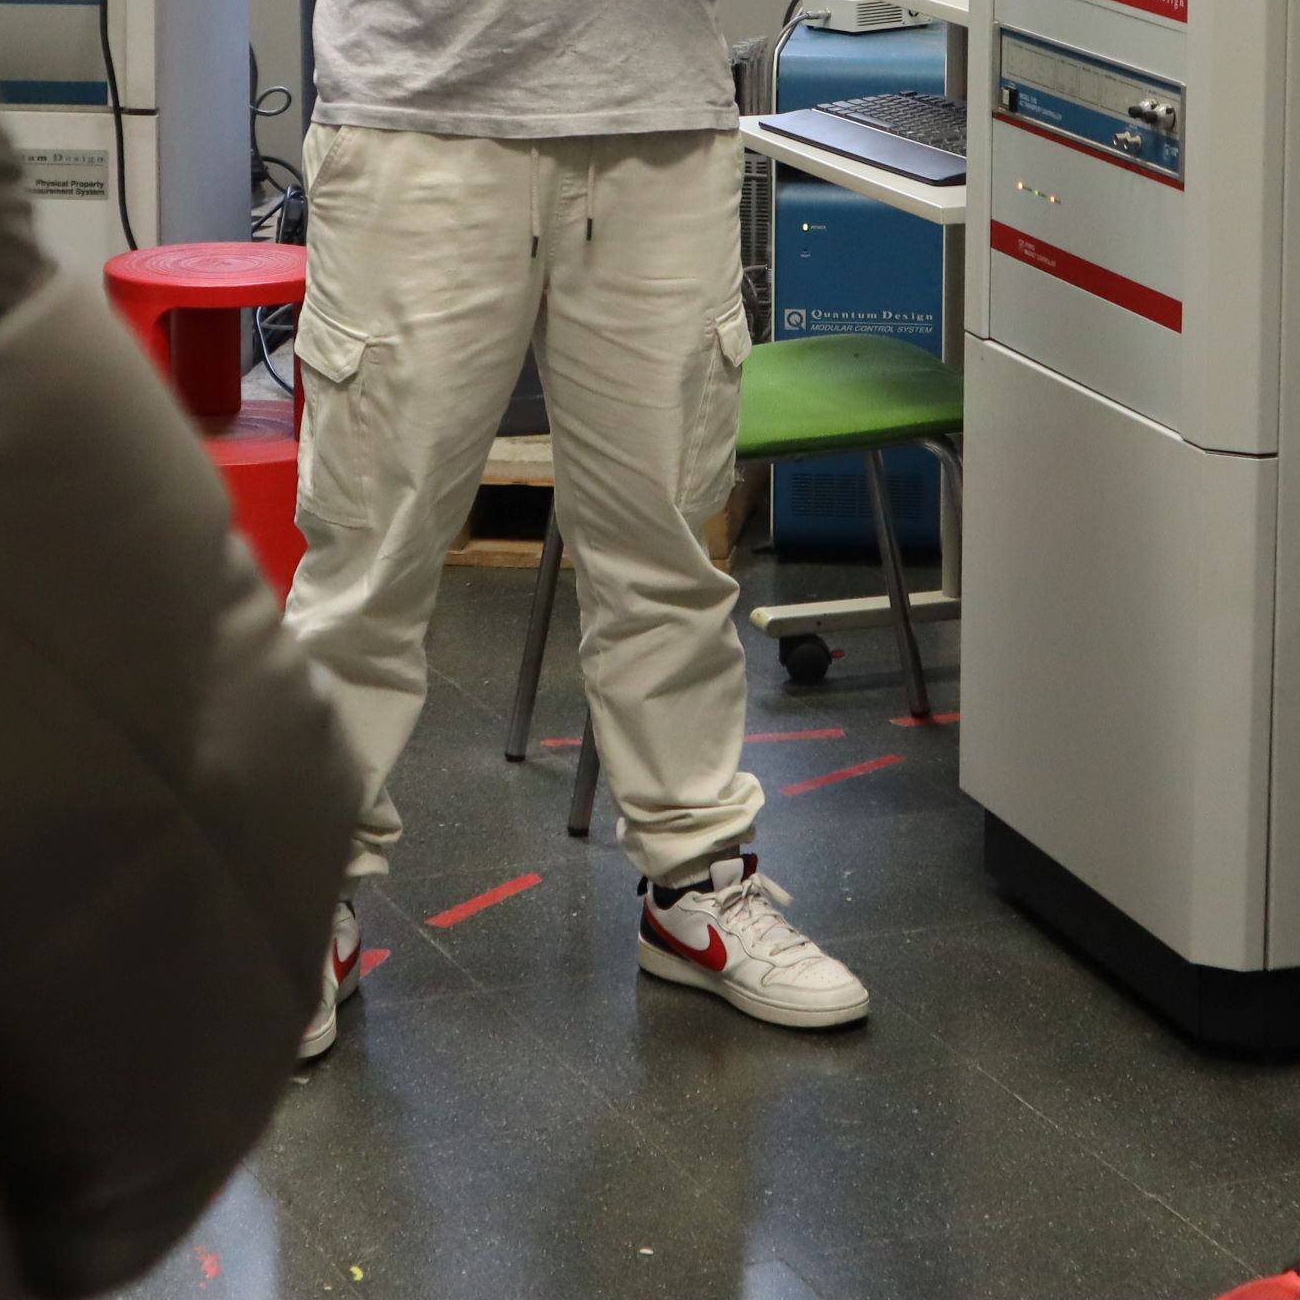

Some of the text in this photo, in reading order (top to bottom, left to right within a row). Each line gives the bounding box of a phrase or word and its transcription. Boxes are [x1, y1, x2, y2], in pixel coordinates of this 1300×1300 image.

[35, 179, 104, 189] Physical Property
[75, 187, 105, 197] System
[811, 309, 933, 322] Quantum Design
[810, 323, 933, 333] MODULAR CONTROL SYSTEM
